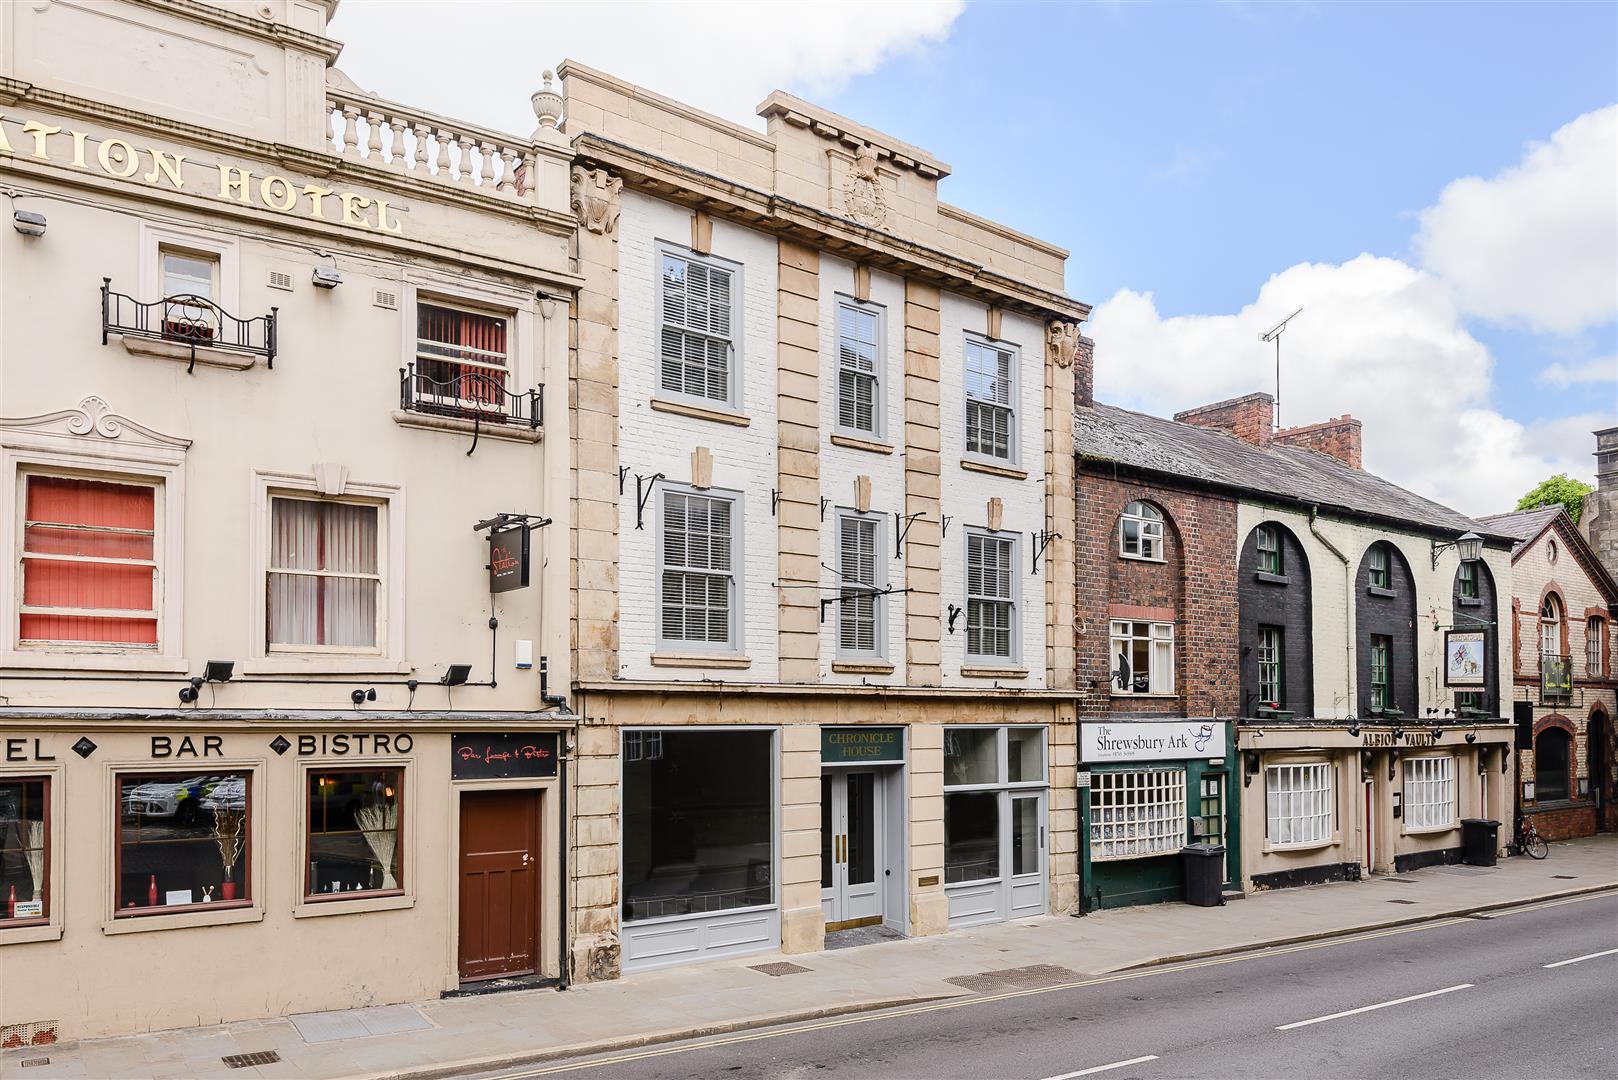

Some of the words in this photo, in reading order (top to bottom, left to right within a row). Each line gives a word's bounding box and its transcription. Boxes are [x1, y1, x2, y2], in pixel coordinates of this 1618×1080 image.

[216, 163, 402, 234] HOTEL
[1098, 726, 1112, 736] The
[829, 733, 894, 744] CHRONICLE
[1097, 734, 1165, 753] Shrewsbury
[1168, 734, 1188, 749] Ark
[1362, 733, 1397, 746] ALBION
[0, 738, 56, 761] EL
[151, 736, 223, 758] BAR
[298, 734, 413, 756] BISTRO
[843, 746, 880, 757] HOUSE
